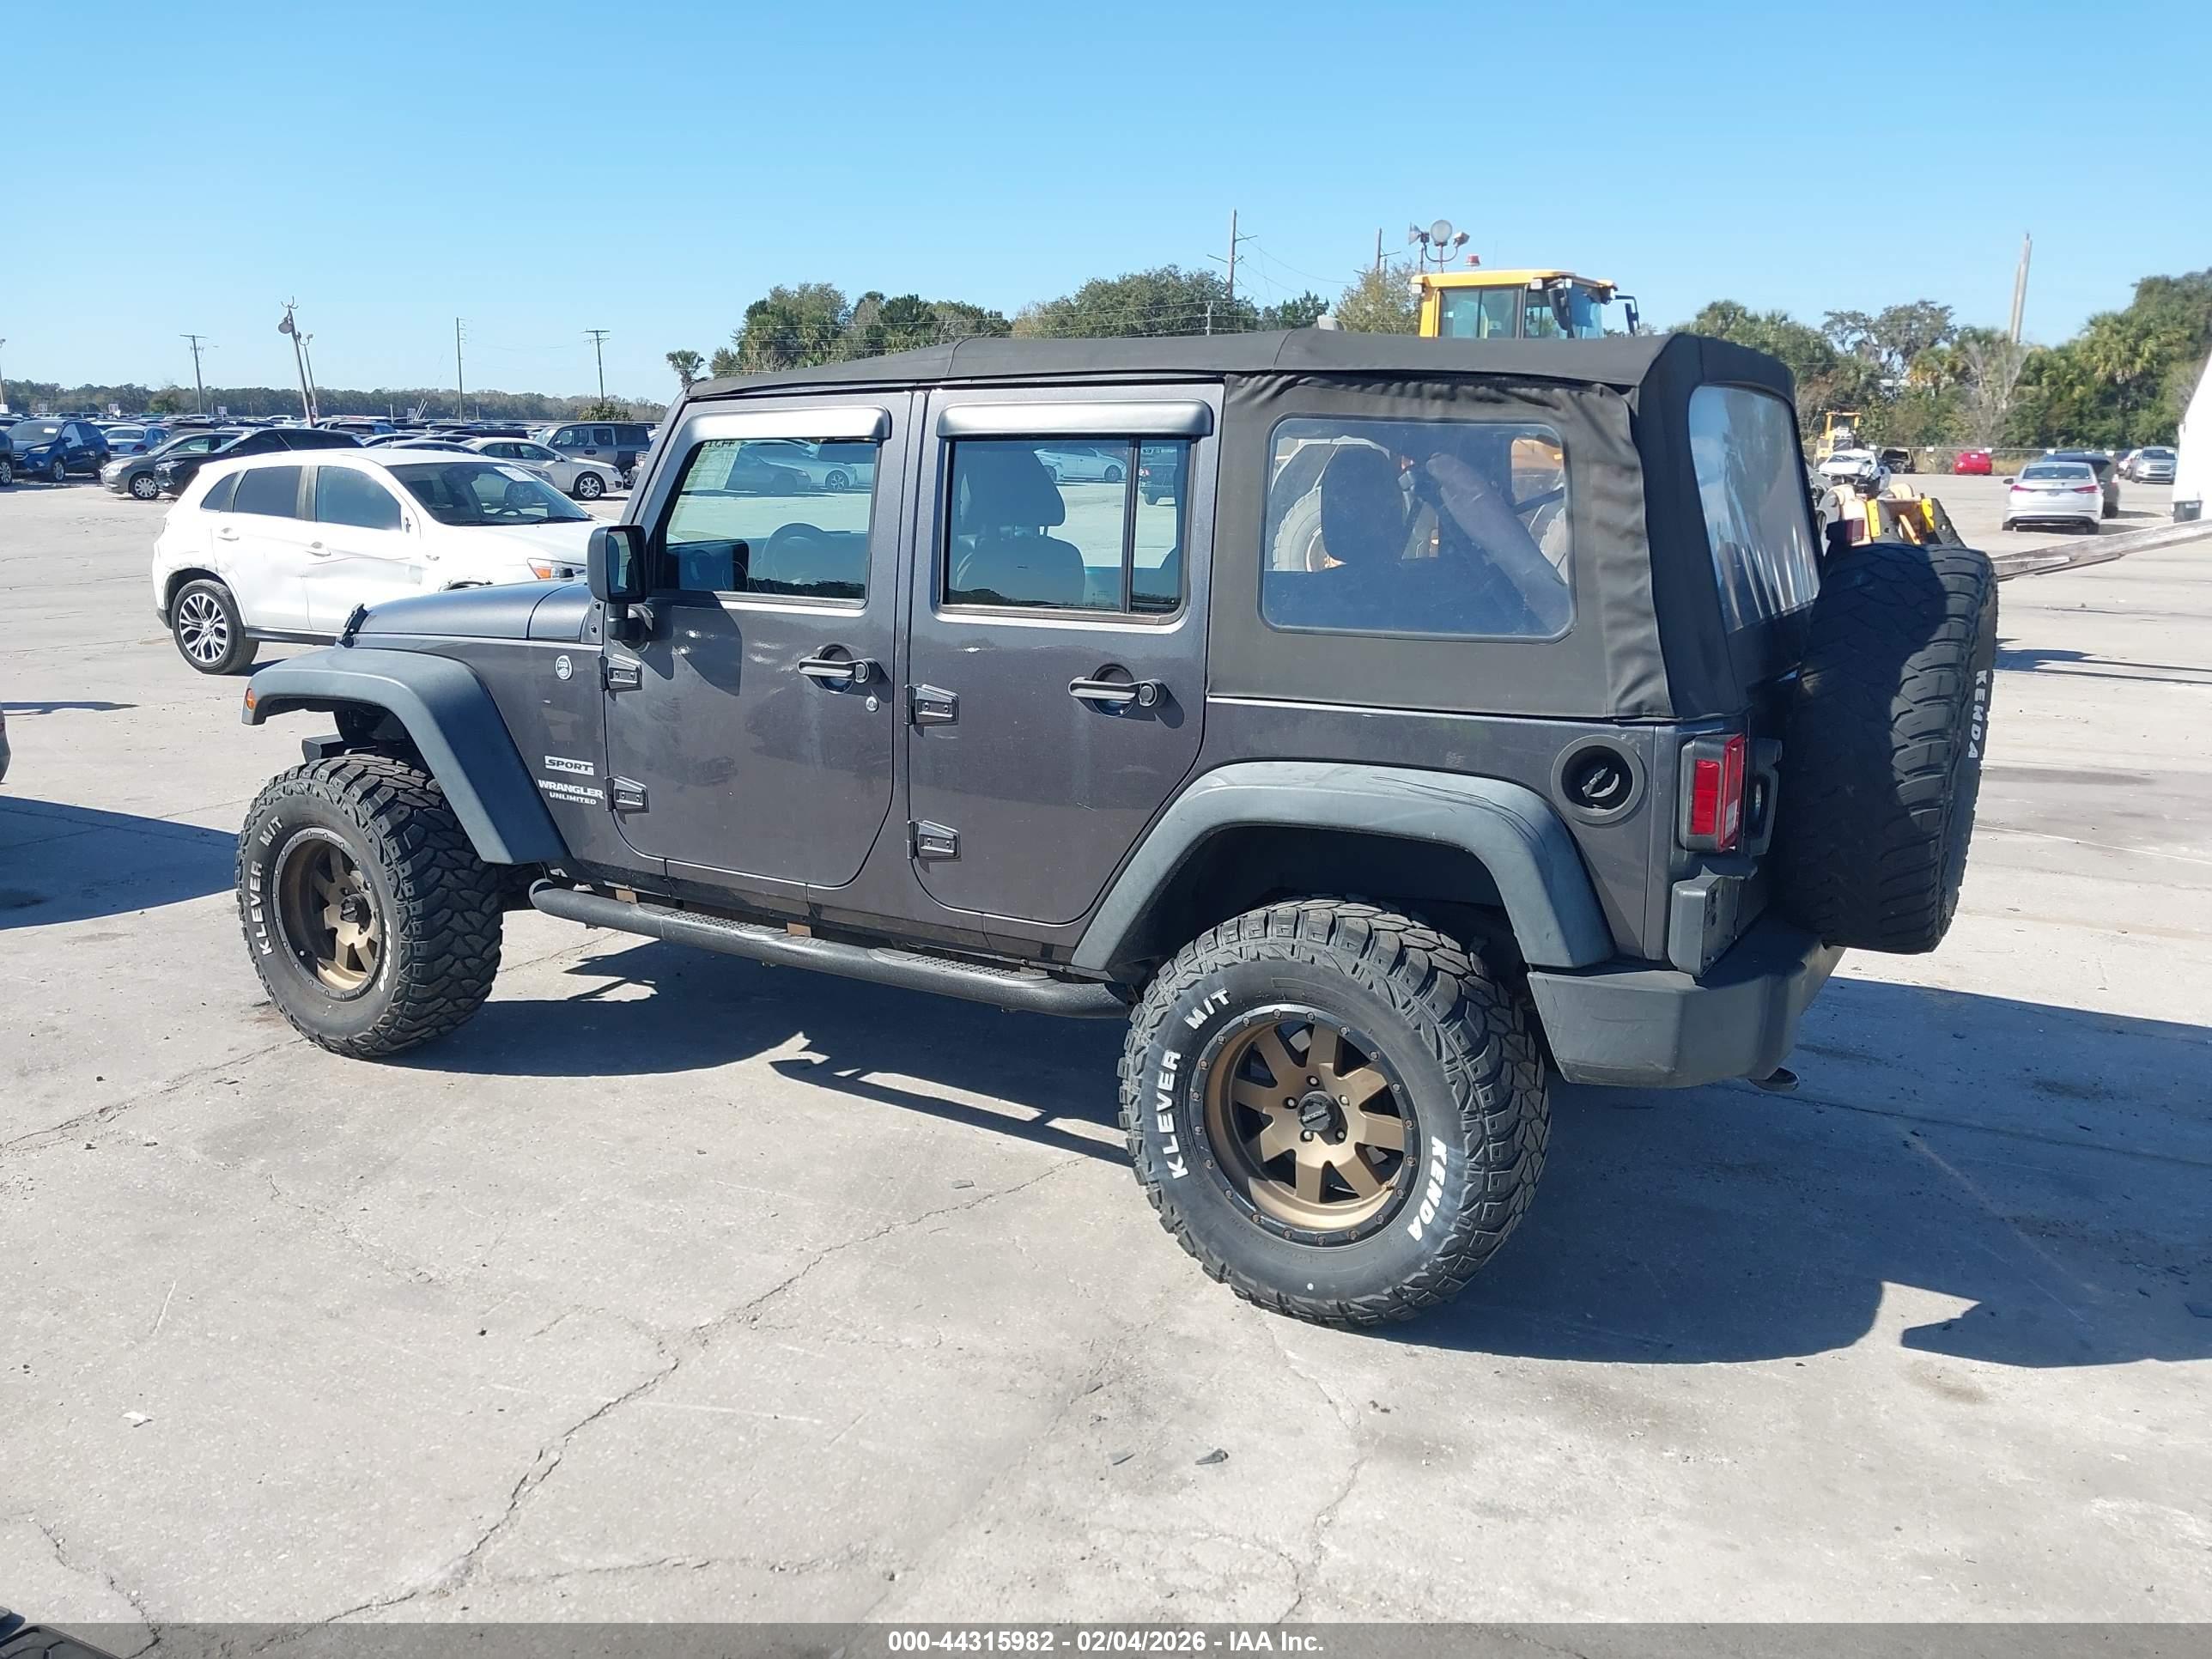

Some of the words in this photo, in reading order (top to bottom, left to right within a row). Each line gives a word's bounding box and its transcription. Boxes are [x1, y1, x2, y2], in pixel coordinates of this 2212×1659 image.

[1968, 670, 1987, 758] KENDA
[538, 779, 605, 799] WRANGLER
[548, 759, 591, 772] SPORT
[550, 792, 597, 805] UNLIMITED
[258, 816, 283, 847] M/T
[249, 860, 273, 956] KLEVER
[1157, 1049, 1189, 1180] KLEVER
[1183, 988, 1231, 1030] M/T
[1407, 1135, 1447, 1242] KENDA
